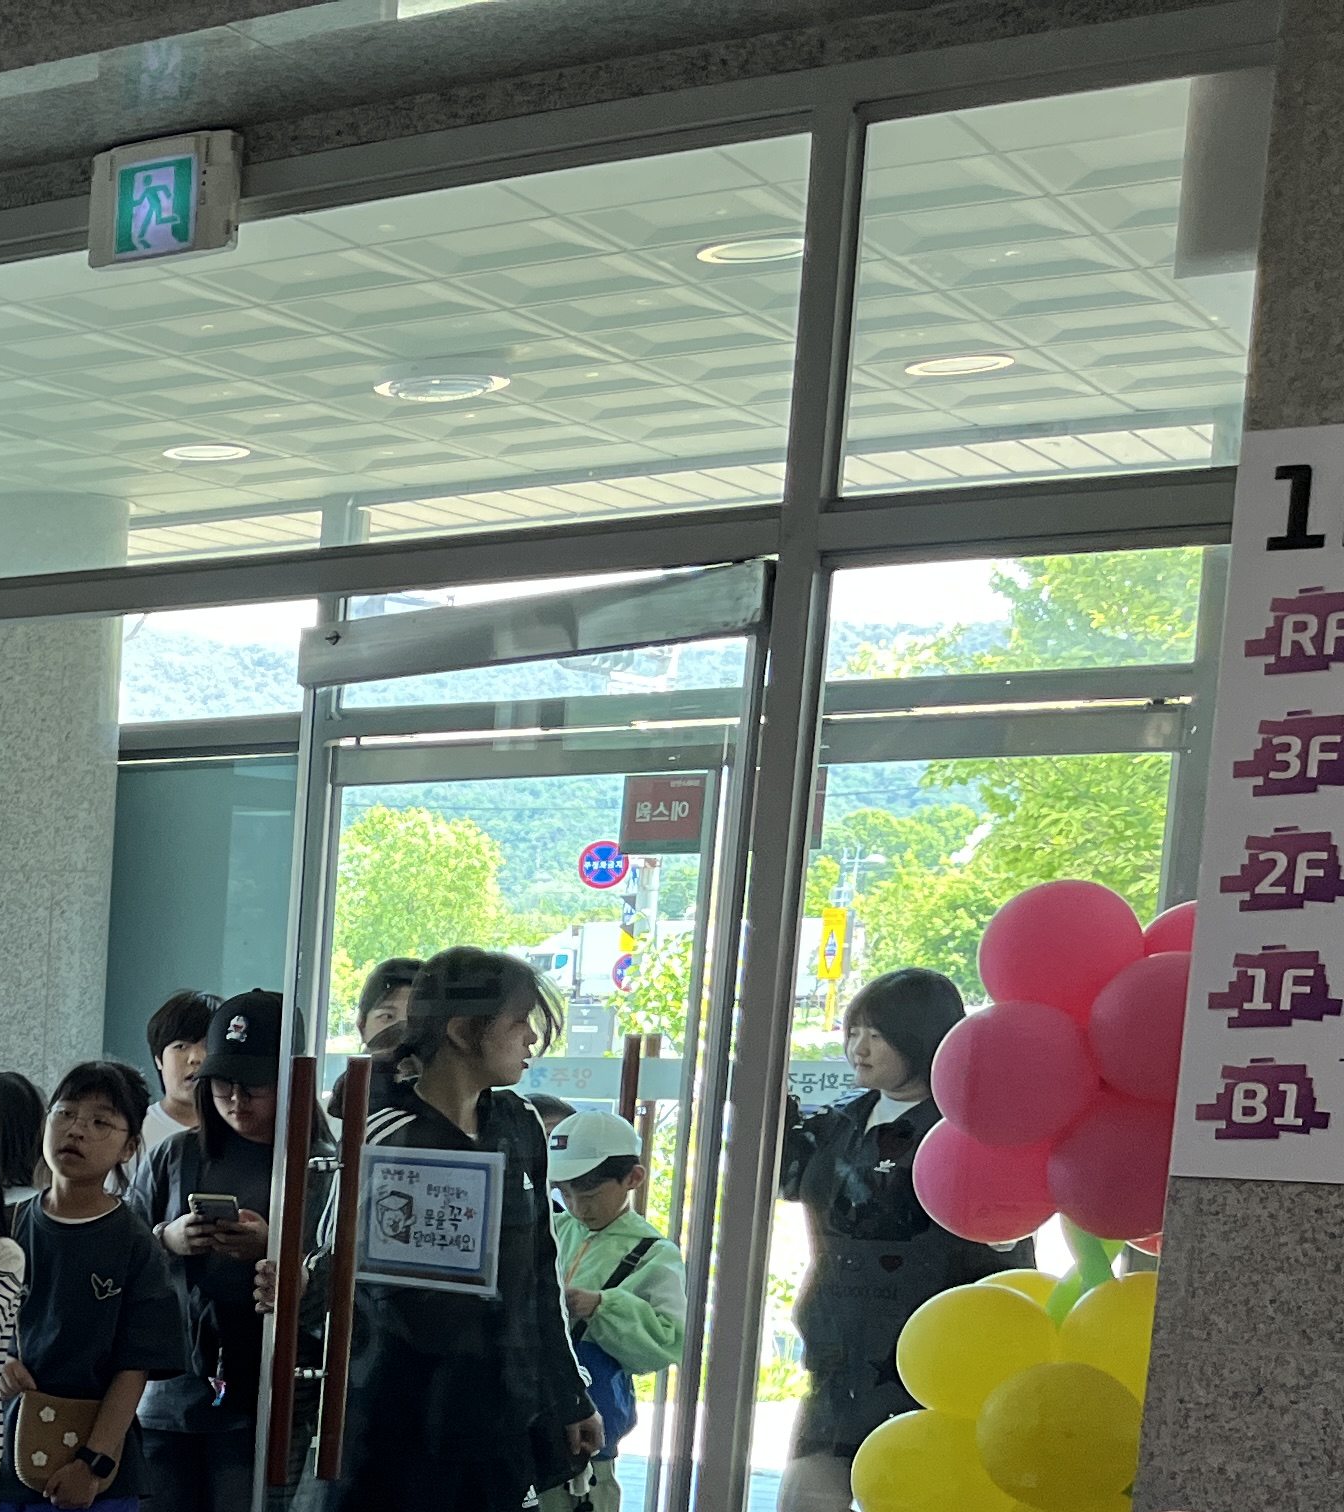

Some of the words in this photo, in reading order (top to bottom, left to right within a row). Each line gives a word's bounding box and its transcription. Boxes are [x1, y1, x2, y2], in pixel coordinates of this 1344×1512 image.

[1265, 463, 1344, 551] 1
[1267, 734, 1343, 780] 3F
[1253, 850, 1329, 895] 2F
[1241, 968, 1315, 1011] 1F
[1230, 1082, 1304, 1127] B1
[424, 1208, 447, 1231] 문을
[448, 1204, 463, 1233] 꼭
